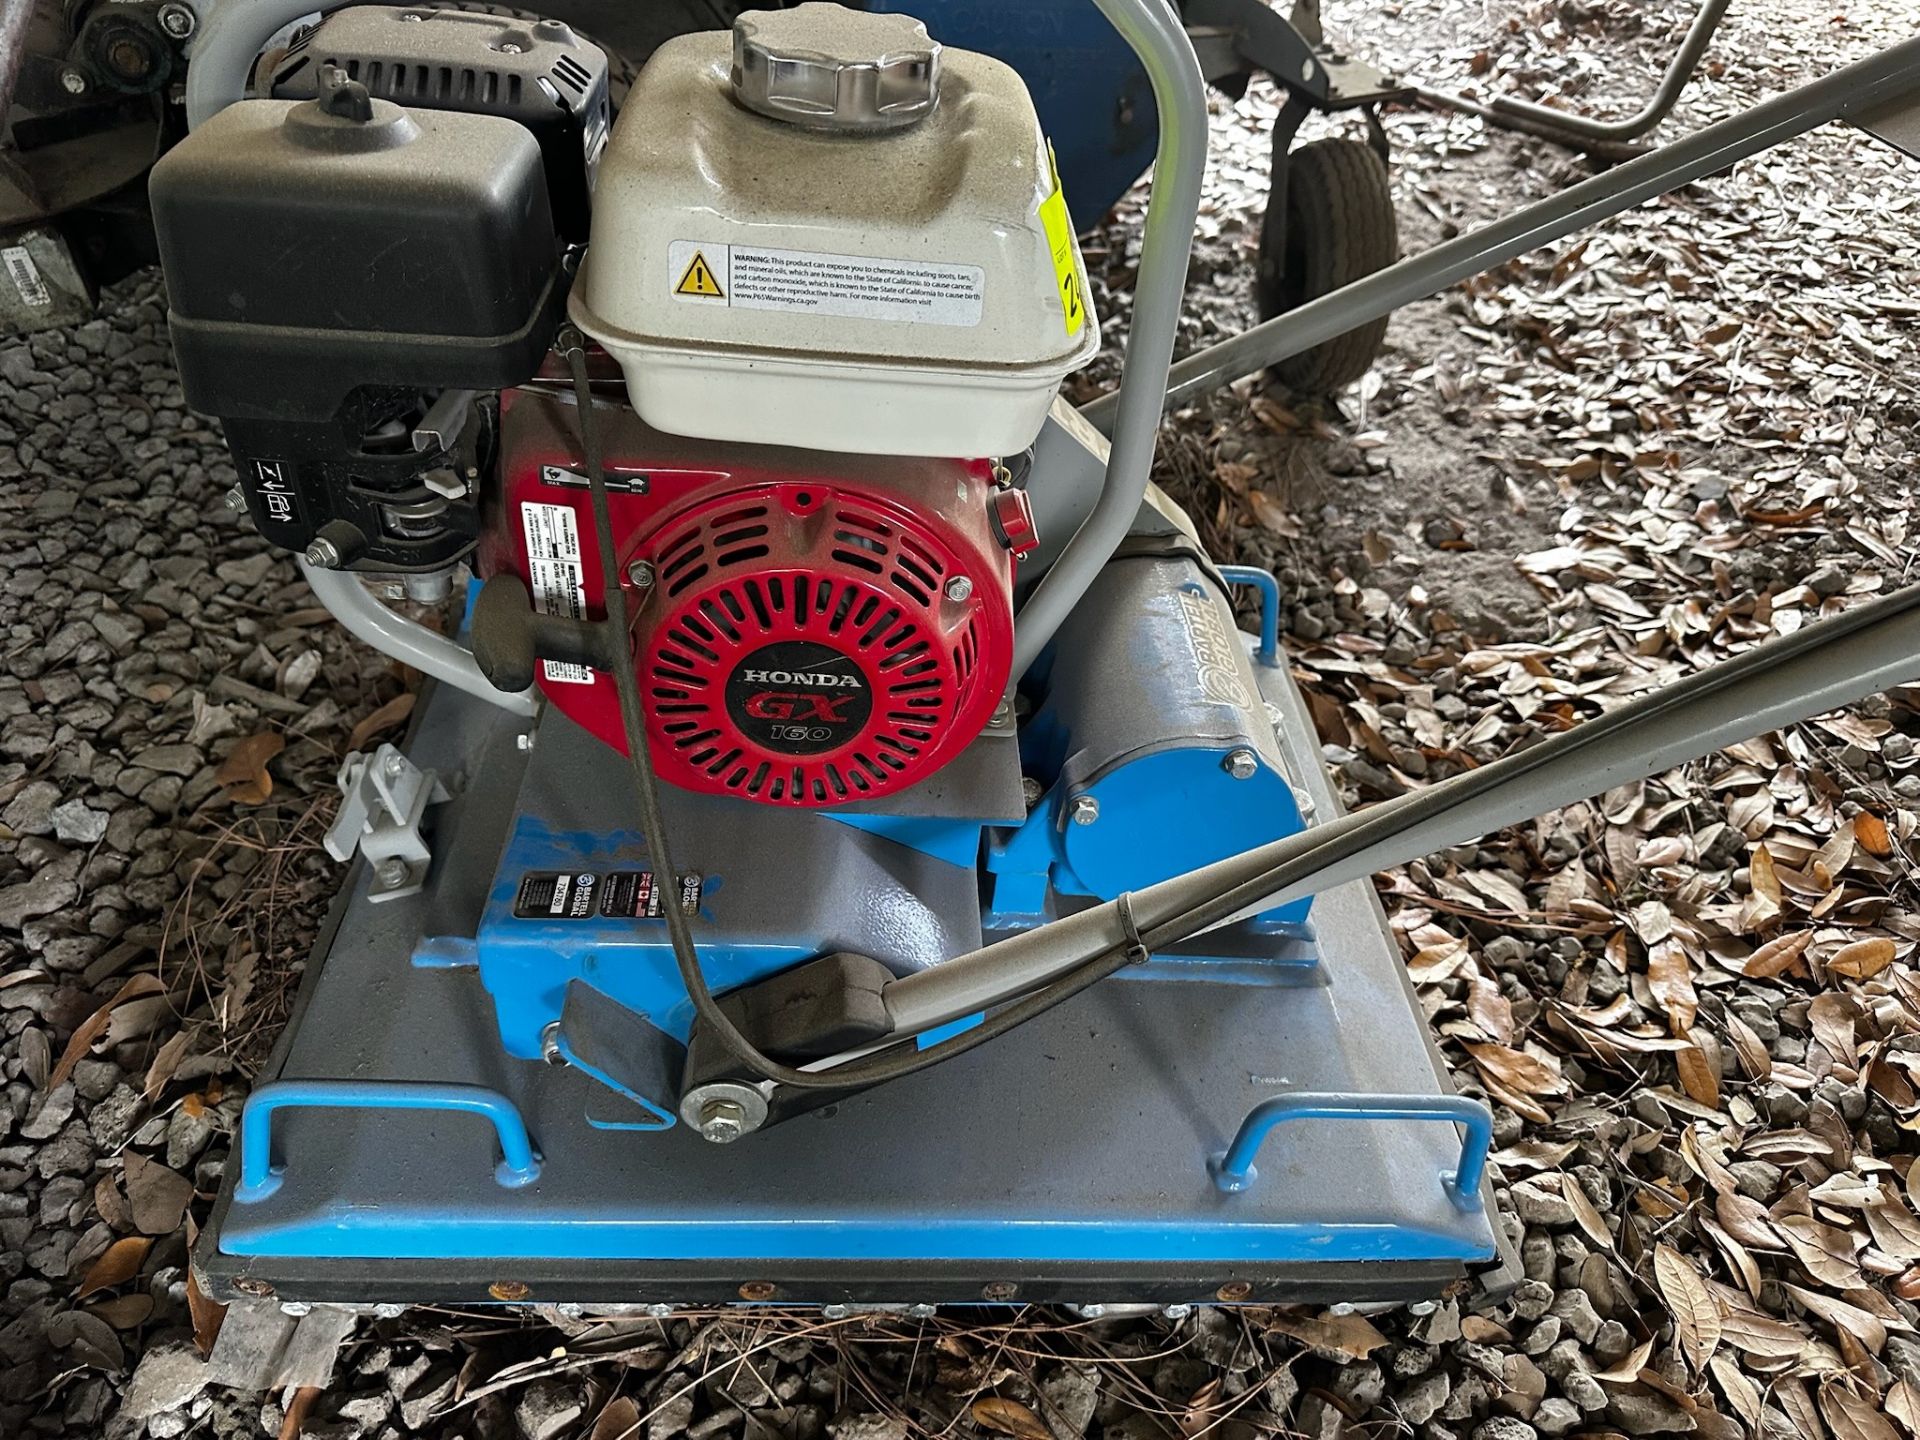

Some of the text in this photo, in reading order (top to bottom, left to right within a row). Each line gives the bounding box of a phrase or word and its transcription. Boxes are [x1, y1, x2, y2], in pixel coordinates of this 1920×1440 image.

[734, 254, 770, 263] WARNING:
[786, 258, 811, 268] product
[827, 263, 849, 271] expose
[873, 266, 905, 276] chemicals
[906, 270, 936, 279] including
[734, 283, 758, 291] defects
[787, 288, 828, 297] reproductive
[880, 295, 917, 304] information
[734, 292, 818, 306] www.P65Warnings.ca.gov
[773, 278, 807, 286] monoxide,
[809, 280, 828, 288] which
[906, 288, 936, 297] California
[1179, 588, 1217, 665] BARTELL
[1201, 598, 1238, 676] GLOBAL
[744, 669, 862, 687] HONDA
[745, 692, 855, 722] GX
[770, 725, 832, 741] 160
[553, 883, 566, 906] 734780
[570, 886, 584, 916] GLOBAL
[578, 886, 592, 916] BARTELL
